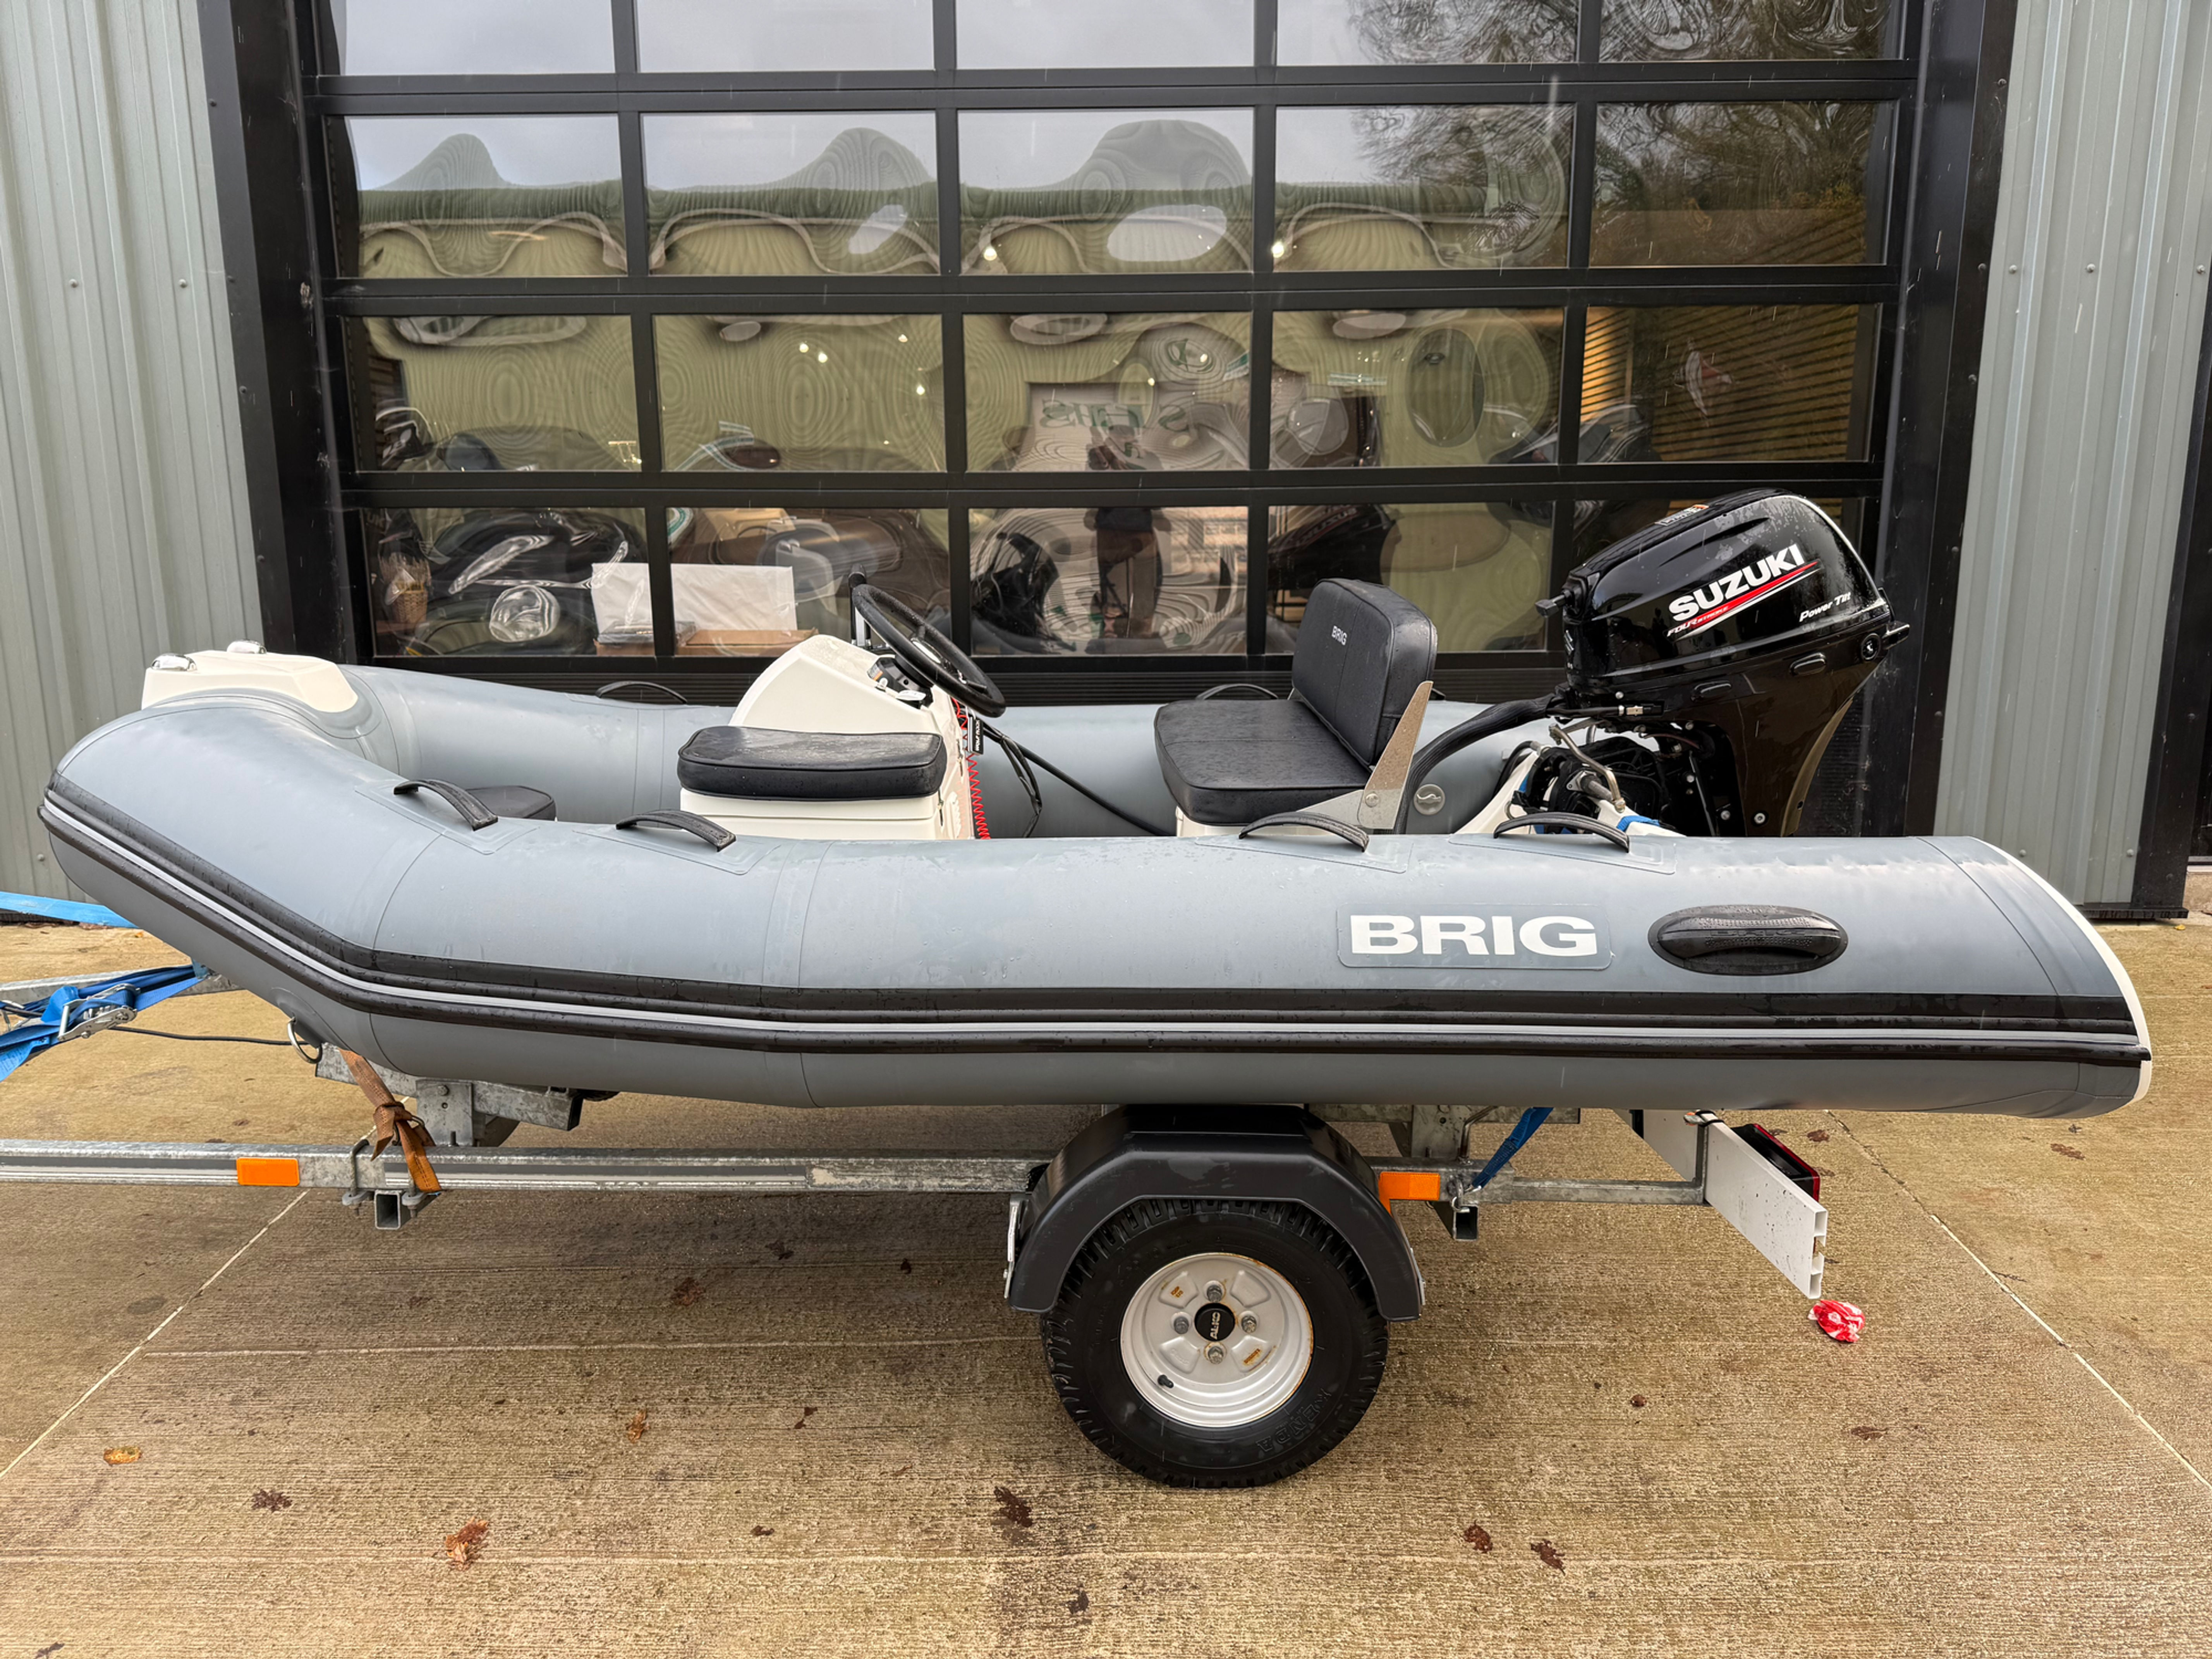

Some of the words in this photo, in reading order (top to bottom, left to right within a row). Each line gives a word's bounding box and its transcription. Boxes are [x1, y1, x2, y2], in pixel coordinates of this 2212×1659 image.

[1669, 544, 1805, 622] SUZUKI
[1799, 601, 1833, 622] Power
[1834, 592, 1851, 606] Tilt
[1331, 625, 1347, 646] BRIG
[1350, 915, 1597, 957] BRIG
